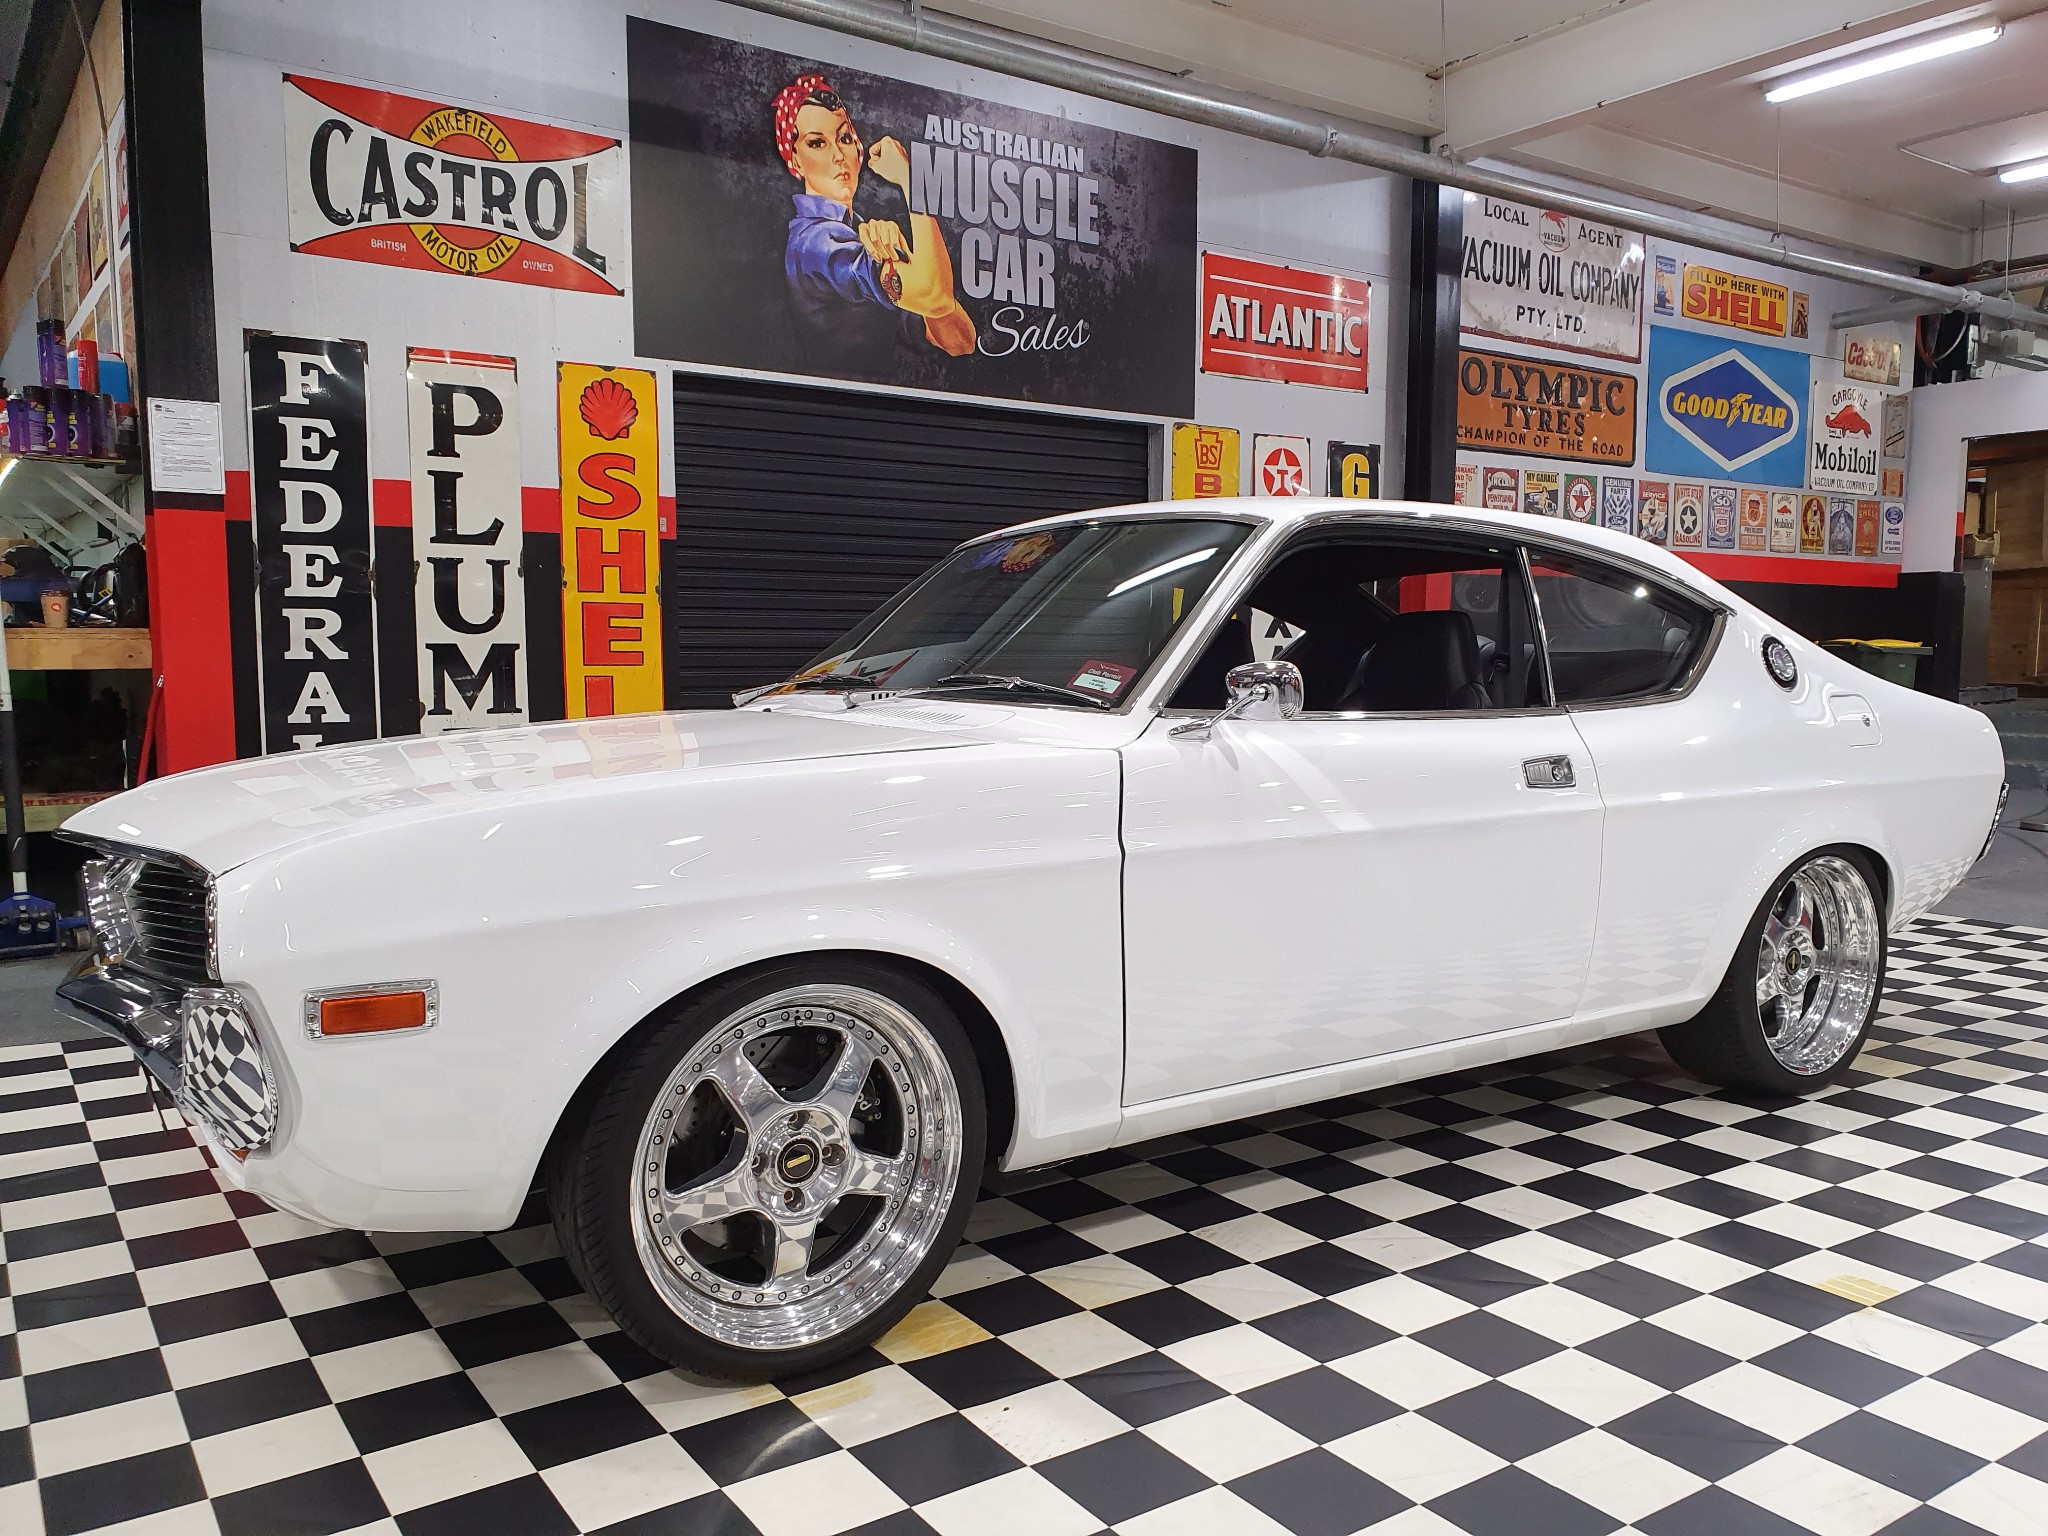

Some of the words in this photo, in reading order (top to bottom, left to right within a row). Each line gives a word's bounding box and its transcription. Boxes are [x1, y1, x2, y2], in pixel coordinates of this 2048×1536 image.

[421, 112, 507, 156] WAKEFIELD
[924, 114, 1084, 172] AUSTRALIAN
[310, 119, 607, 275] CASTROL
[909, 141, 1100, 245] MUSCLE
[1484, 197, 1529, 227] LOCAL
[1578, 222, 1623, 249] AGENT
[370, 238, 407, 252] BRITISH
[422, 229, 479, 271] MOTOR
[486, 236, 514, 265] OIL
[522, 259, 554, 273] OWNED
[960, 228, 1056, 309] CAR
[1538, 252, 1564, 298] OIL
[1570, 260, 1640, 313] COMPANY
[1689, 270, 1712, 284] FILL
[1715, 275, 1728, 287] UP
[1730, 279, 1758, 295] HERE
[1761, 285, 1785, 301] WITH
[1208, 293, 1363, 356] ATLANTIC
[1686, 283, 1784, 332] SHELL
[977, 306, 1091, 357] Sales
[1461, 356, 1626, 416] OLYMPIC
[1501, 401, 1585, 437] TYRES
[1456, 425, 1526, 446] CHAMPION
[1533, 434, 1550, 448] OF
[1559, 437, 1583, 452] THE
[1592, 442, 1624, 457] ROAD
[1814, 441, 1877, 476] Mobiloil
[1526, 472, 1536, 481] MY
[1536, 473, 1558, 483] GARAGE
[1604, 478, 1632, 488] GENUINE
[1610, 487, 1628, 496] PARTS
[1642, 491, 1666, 499] SERVICE
[1858, 509, 1879, 519] SHELL
[276, 350, 351, 751] FEDERA
[426, 382, 523, 732] PLUM
[1674, 530, 1701, 544] GASOLINE
